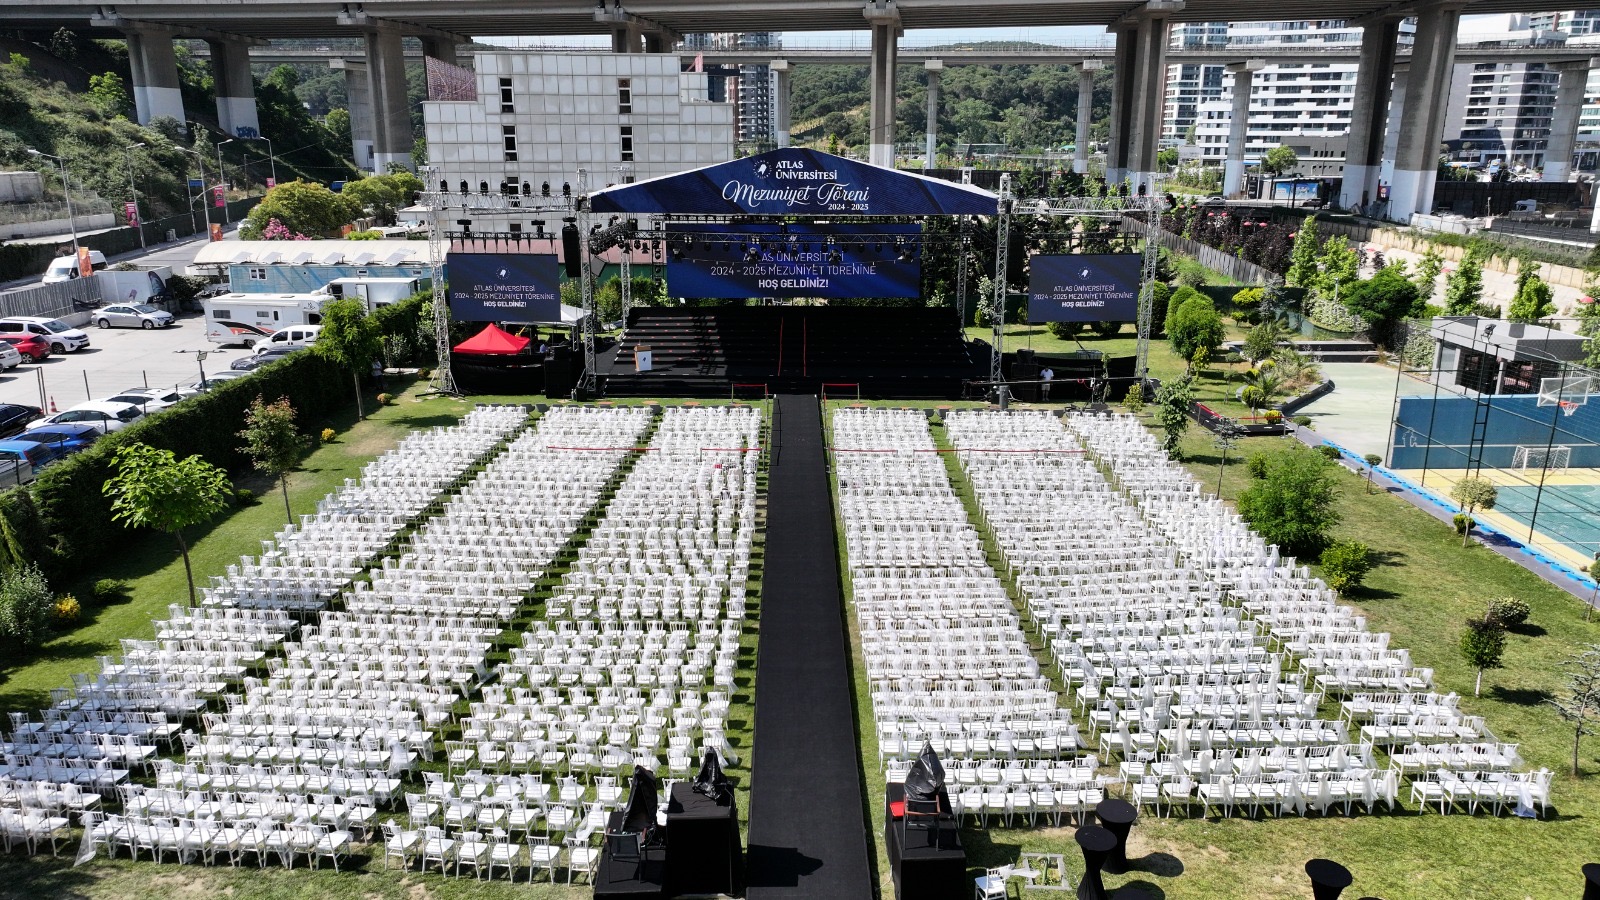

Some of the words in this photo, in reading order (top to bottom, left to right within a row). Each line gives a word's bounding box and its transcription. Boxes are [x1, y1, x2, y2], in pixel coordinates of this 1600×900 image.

[775, 160, 804, 169] ATLAS
[775, 169, 838, 180] ÜNİVERSİTESİ
[721, 179, 819, 208] Mezuniyet
[816, 182, 870, 206] Töreni
[710, 266, 734, 276] 2024
[743, 266, 767, 276] 2025
[768, 264, 824, 276] MEZUNİYET
[494, 284, 536, 292] ÜNİVERSİTESİ
[758, 279, 778, 290] HOŞ
[780, 277, 829, 288] GELDİNİZ!
[1061, 301, 1074, 309] HOŞ
